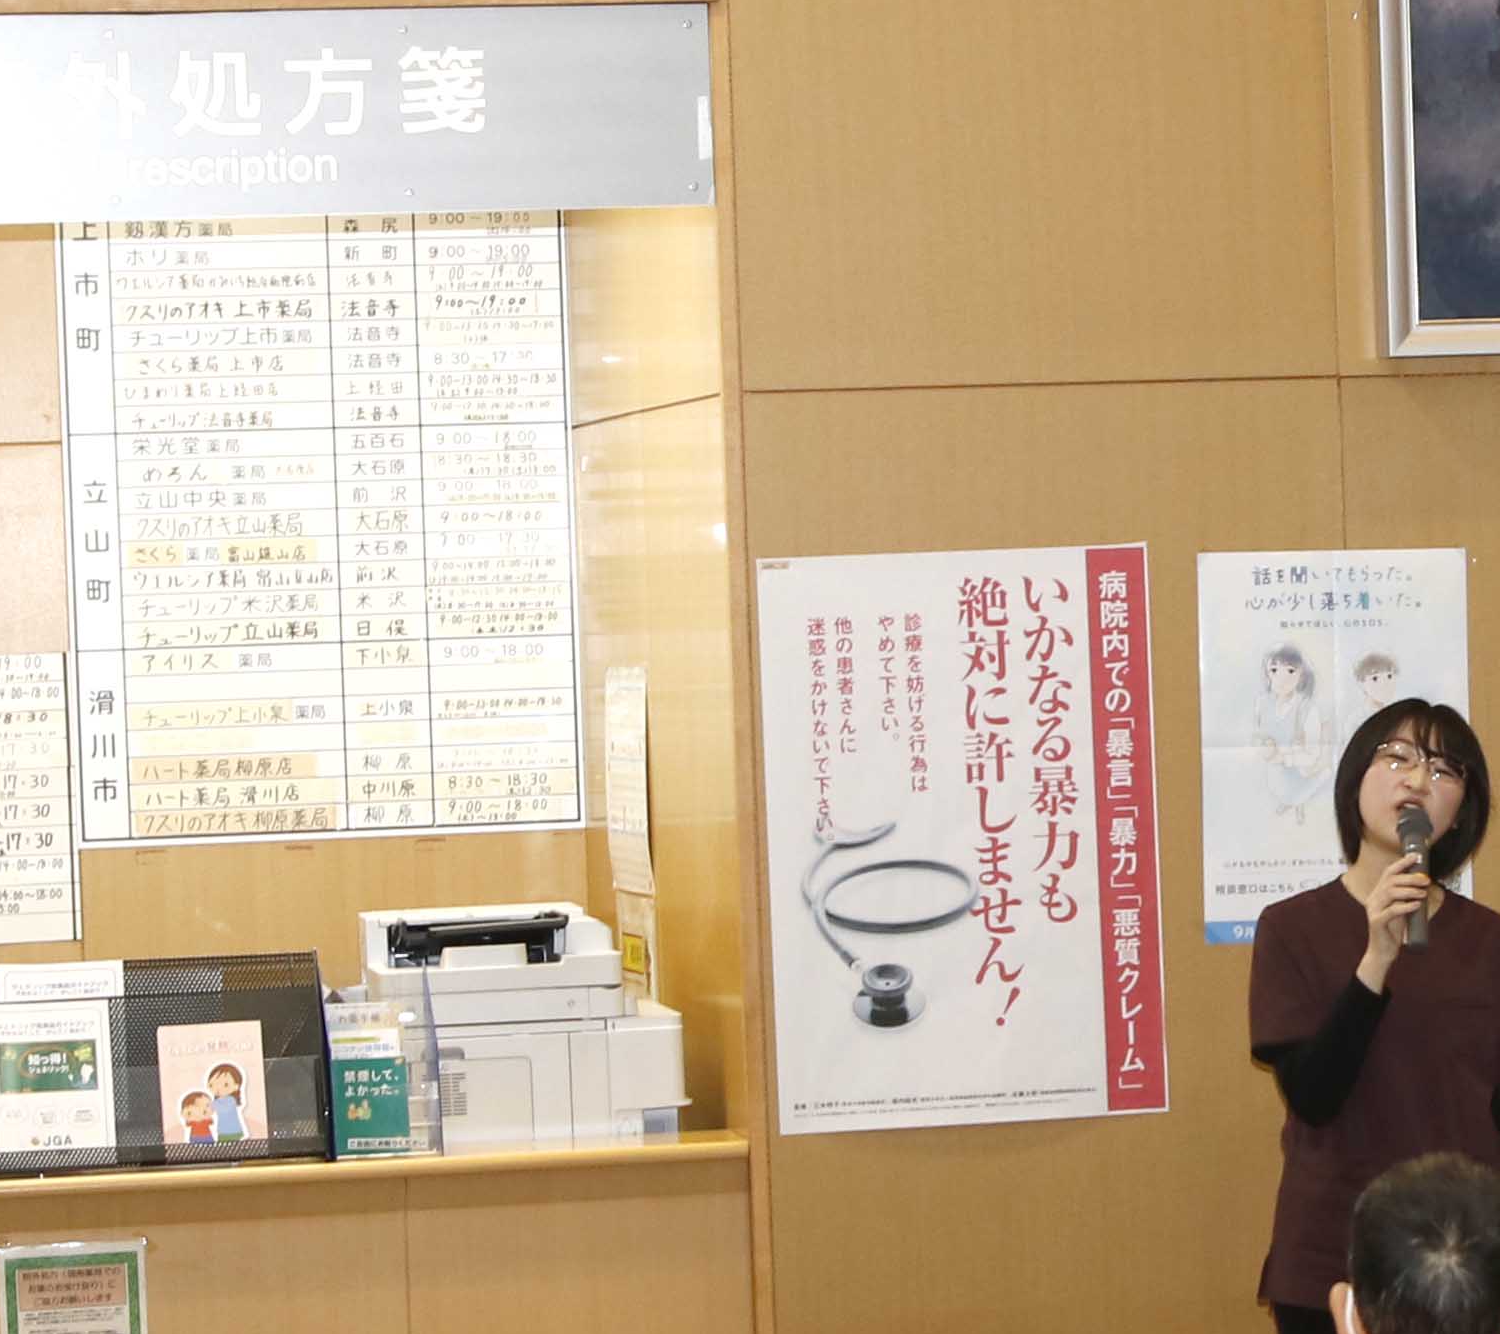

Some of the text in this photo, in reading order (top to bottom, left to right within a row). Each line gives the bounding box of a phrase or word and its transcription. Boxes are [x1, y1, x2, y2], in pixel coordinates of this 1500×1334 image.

[112, 148, 340, 195] rescription
[132, 436, 241, 456] 栄光堂薬局
[352, 433, 405, 449] 五百石
[135, 490, 267, 509] 立山中央薬局
[83, 479, 112, 604] 立山町
[137, 622, 318, 649] チューリップ立山薬局
[834, 617, 862, 754] 他の患者さんに
[877, 616, 904, 741] やめて下さい。
[904, 613, 933, 793] 診療を妨げる行為は
[88, 689, 118, 803] 滑川市
[143, 756, 293, 780] ハート薬局柳原店
[1021, 574, 1080, 924] いかなる暴力も
[43, 1136, 73, 1147] JGA
